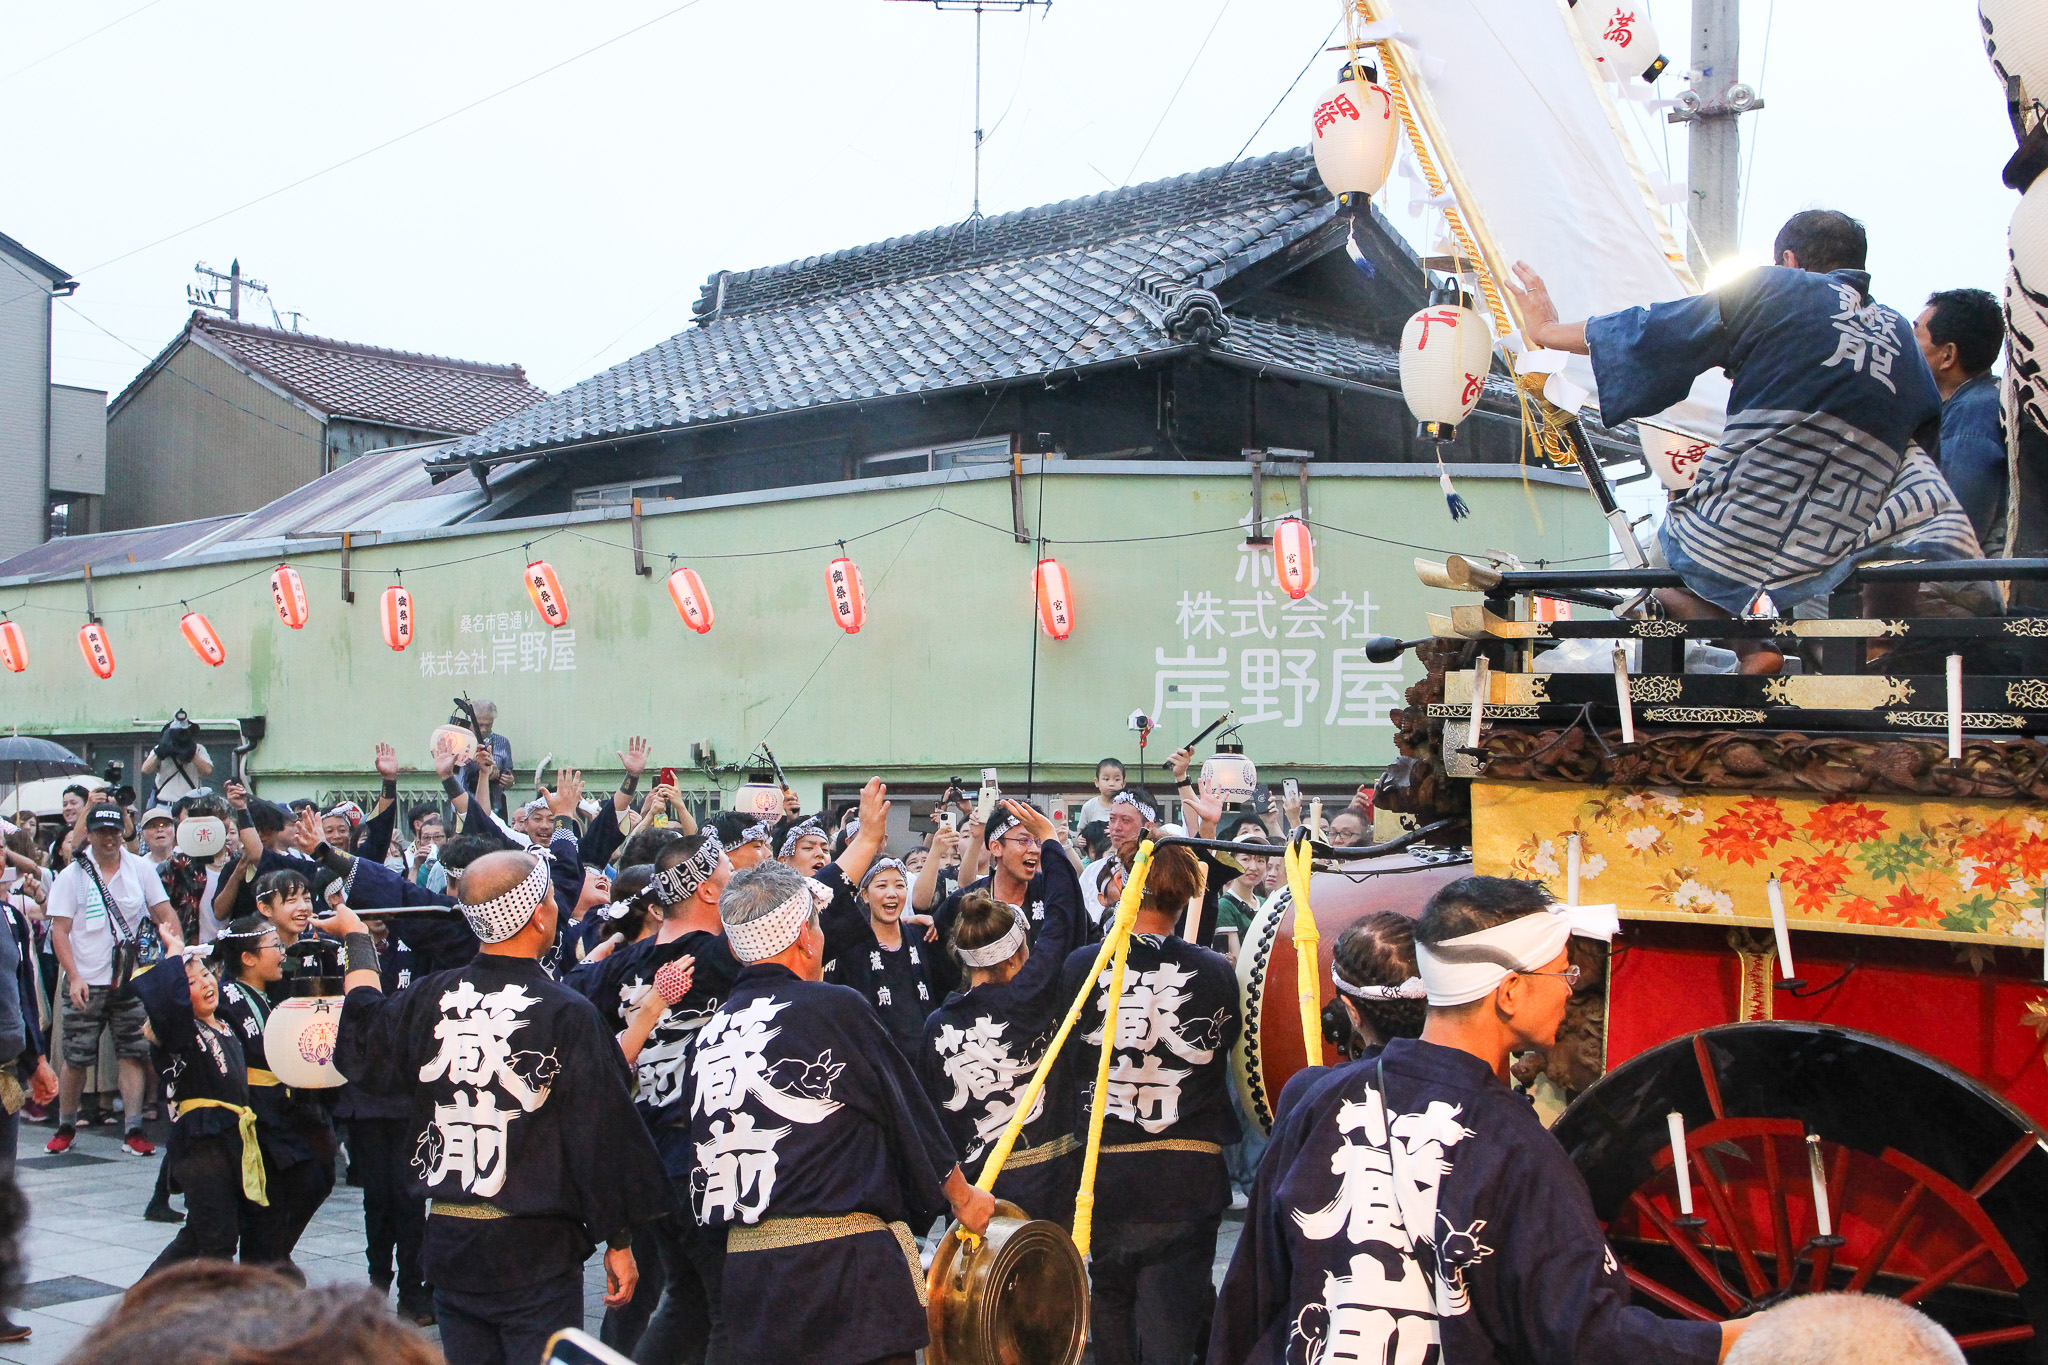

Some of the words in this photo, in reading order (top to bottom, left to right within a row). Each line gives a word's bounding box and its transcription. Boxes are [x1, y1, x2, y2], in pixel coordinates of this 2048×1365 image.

[460, 610, 534, 634] 桑名市宮通り
[1175, 590, 1382, 640] 株式会社
[1150, 644, 1405, 728] 岸野屋
[222, 983, 260, 1039] 蔵前
[870, 951, 892, 1007] 蔵前
[1081, 960, 1214, 1134] 蔵前
[418, 978, 551, 1198] 蔵前
[690, 994, 846, 1225] 蔵前
